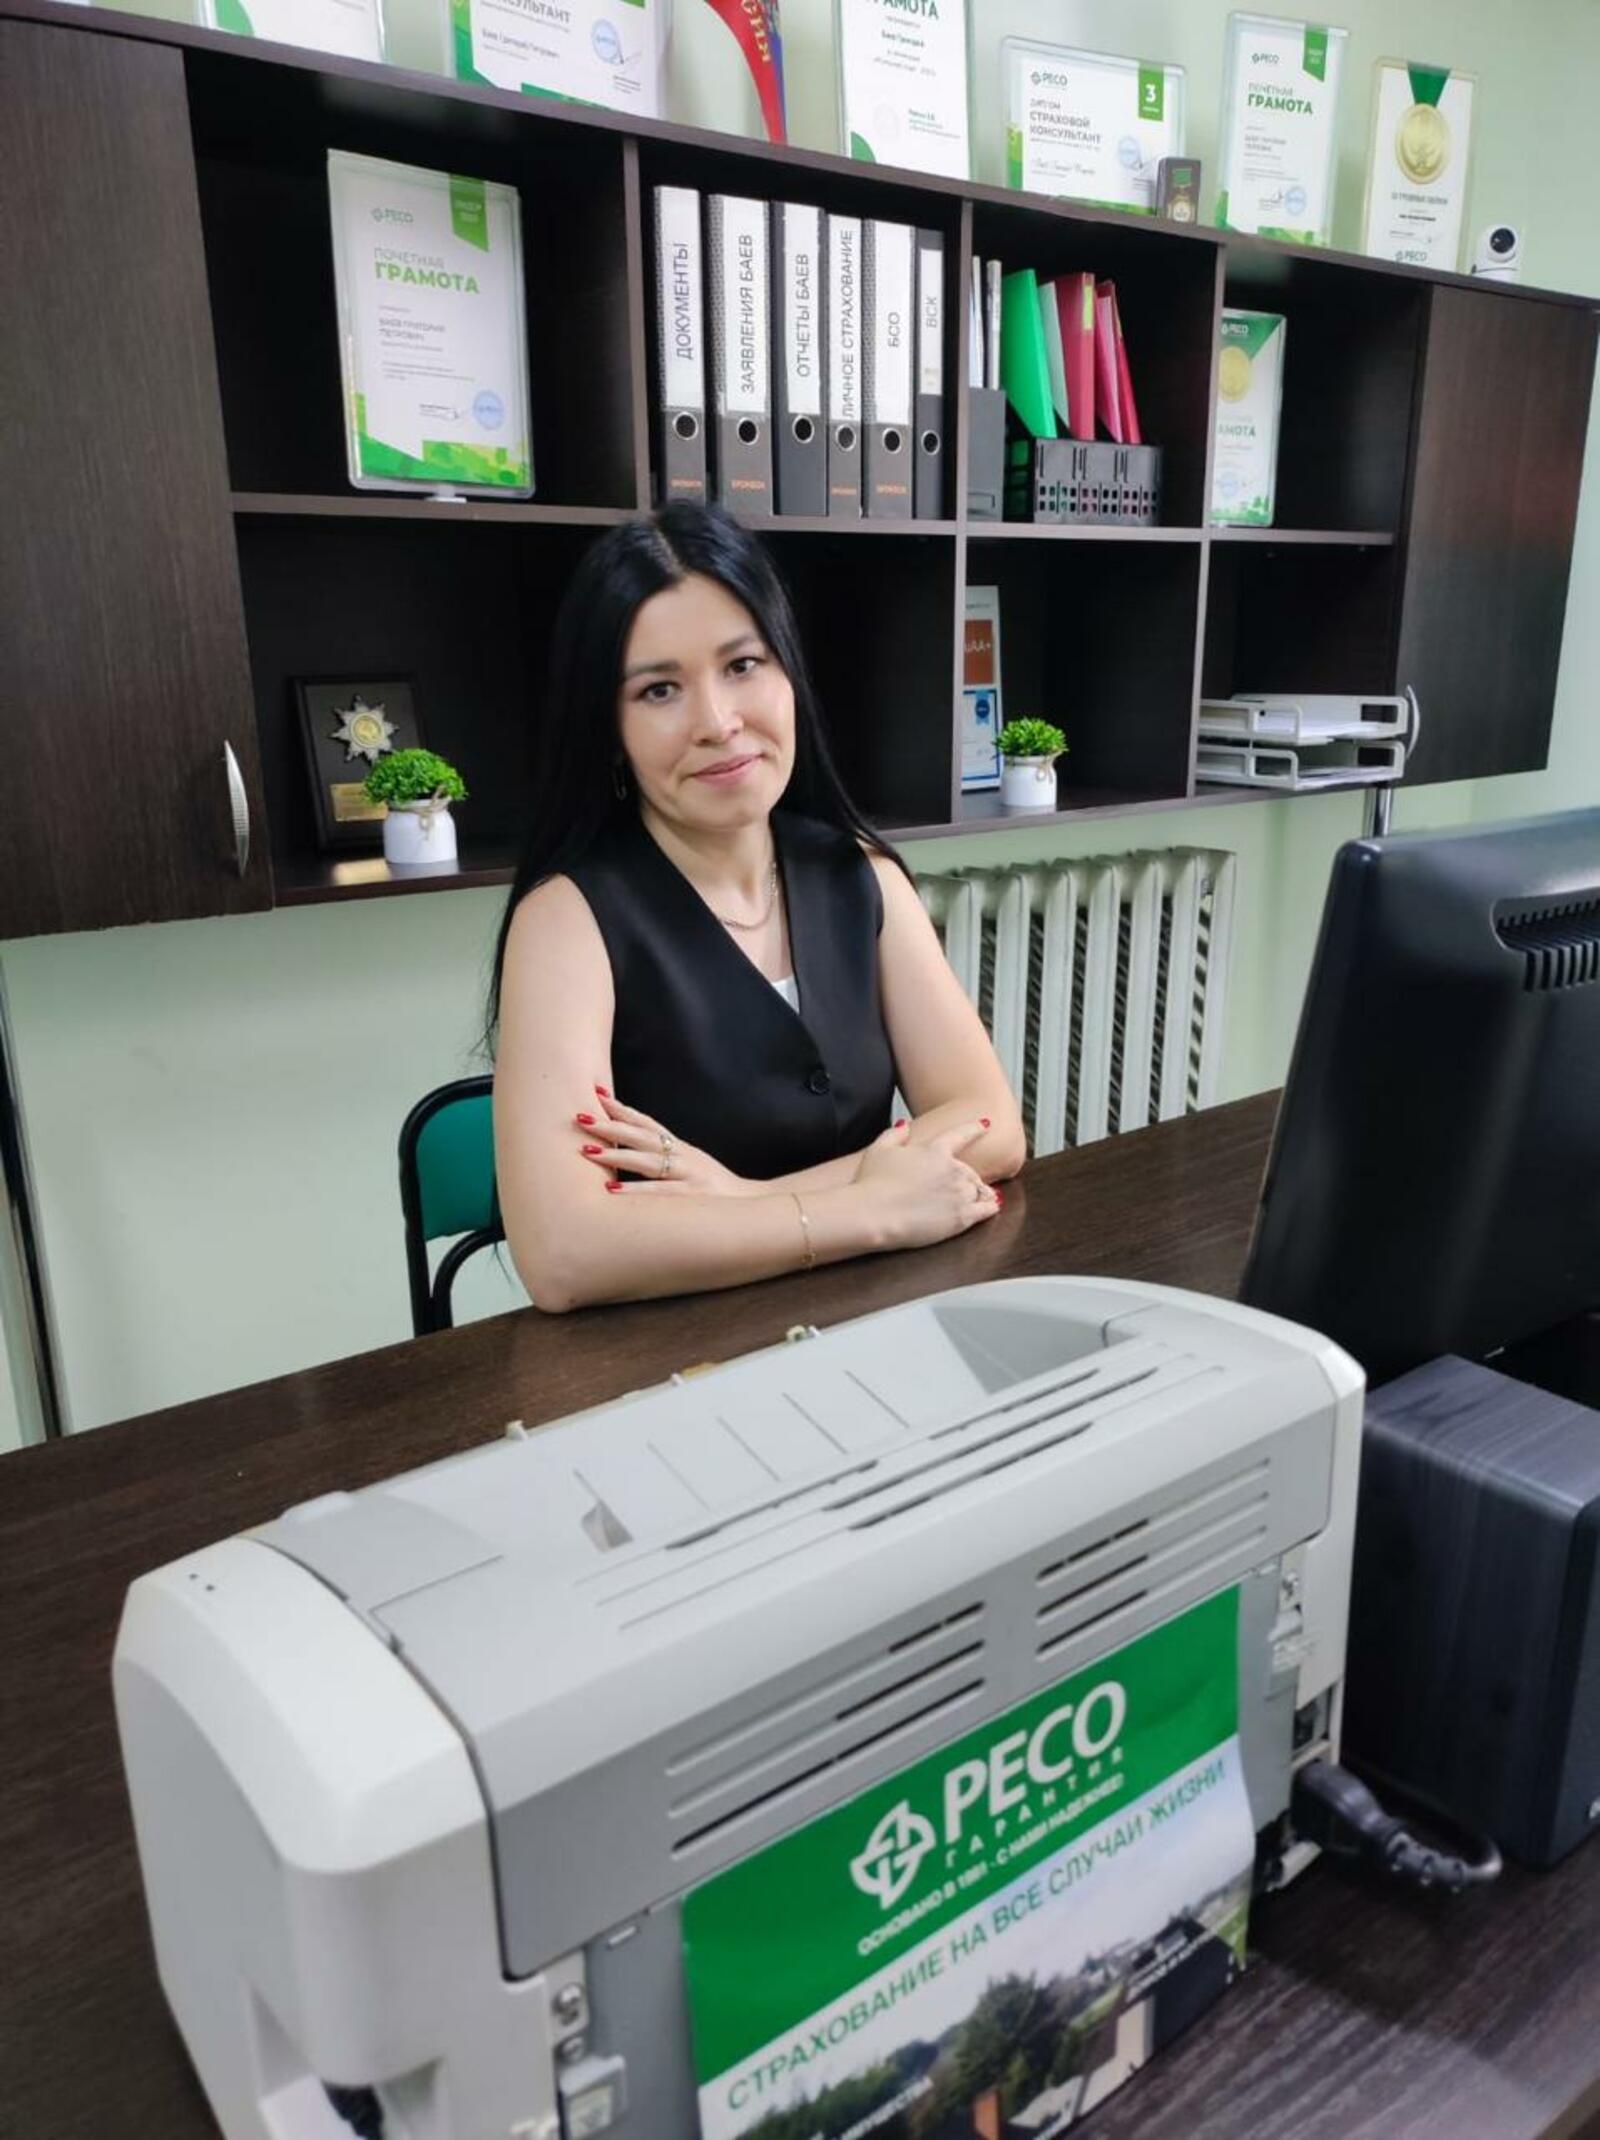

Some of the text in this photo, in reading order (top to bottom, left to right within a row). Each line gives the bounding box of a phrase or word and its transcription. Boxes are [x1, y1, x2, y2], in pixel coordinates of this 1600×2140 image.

[1042, 73, 1068, 86] РЕСО
[1145, 84, 1157, 103] 3
[1029, 111, 1091, 128] СТРАХОВОЙ
[1248, 94, 1314, 115] ГРАМОТА
[1030, 125, 1101, 144] КОНСУЛЬТАНТ
[385, 209, 414, 224] РЕСО
[1405, 250, 1428, 262] РЕСО
[375, 262, 480, 295] ГРАМОТА
[673, 243, 694, 360] ДОКУМЕНТЫ
[738, 234, 756, 394] ЗАЯВЛЕНИЯ БАЕВ
[796, 253, 811, 378] ОТЧЕТЫ БАЕВ
[925, 296, 938, 329] ВСК
[841, 229, 856, 418] ЛИЧНОЕ СТРАХОВАНИЕ
[887, 311, 900, 348] БСО
[944, 1681, 1127, 1846] РЕСО
[727, 1949, 945, 2111] СТРАХОВАНИЕ
[949, 1922, 989, 1964] НА
[992, 1882, 1045, 1935] ВСЕ
[1047, 1813, 1143, 1896] СЛУЧАИ
[1146, 1757, 1226, 1831] ЖИЗНИ
